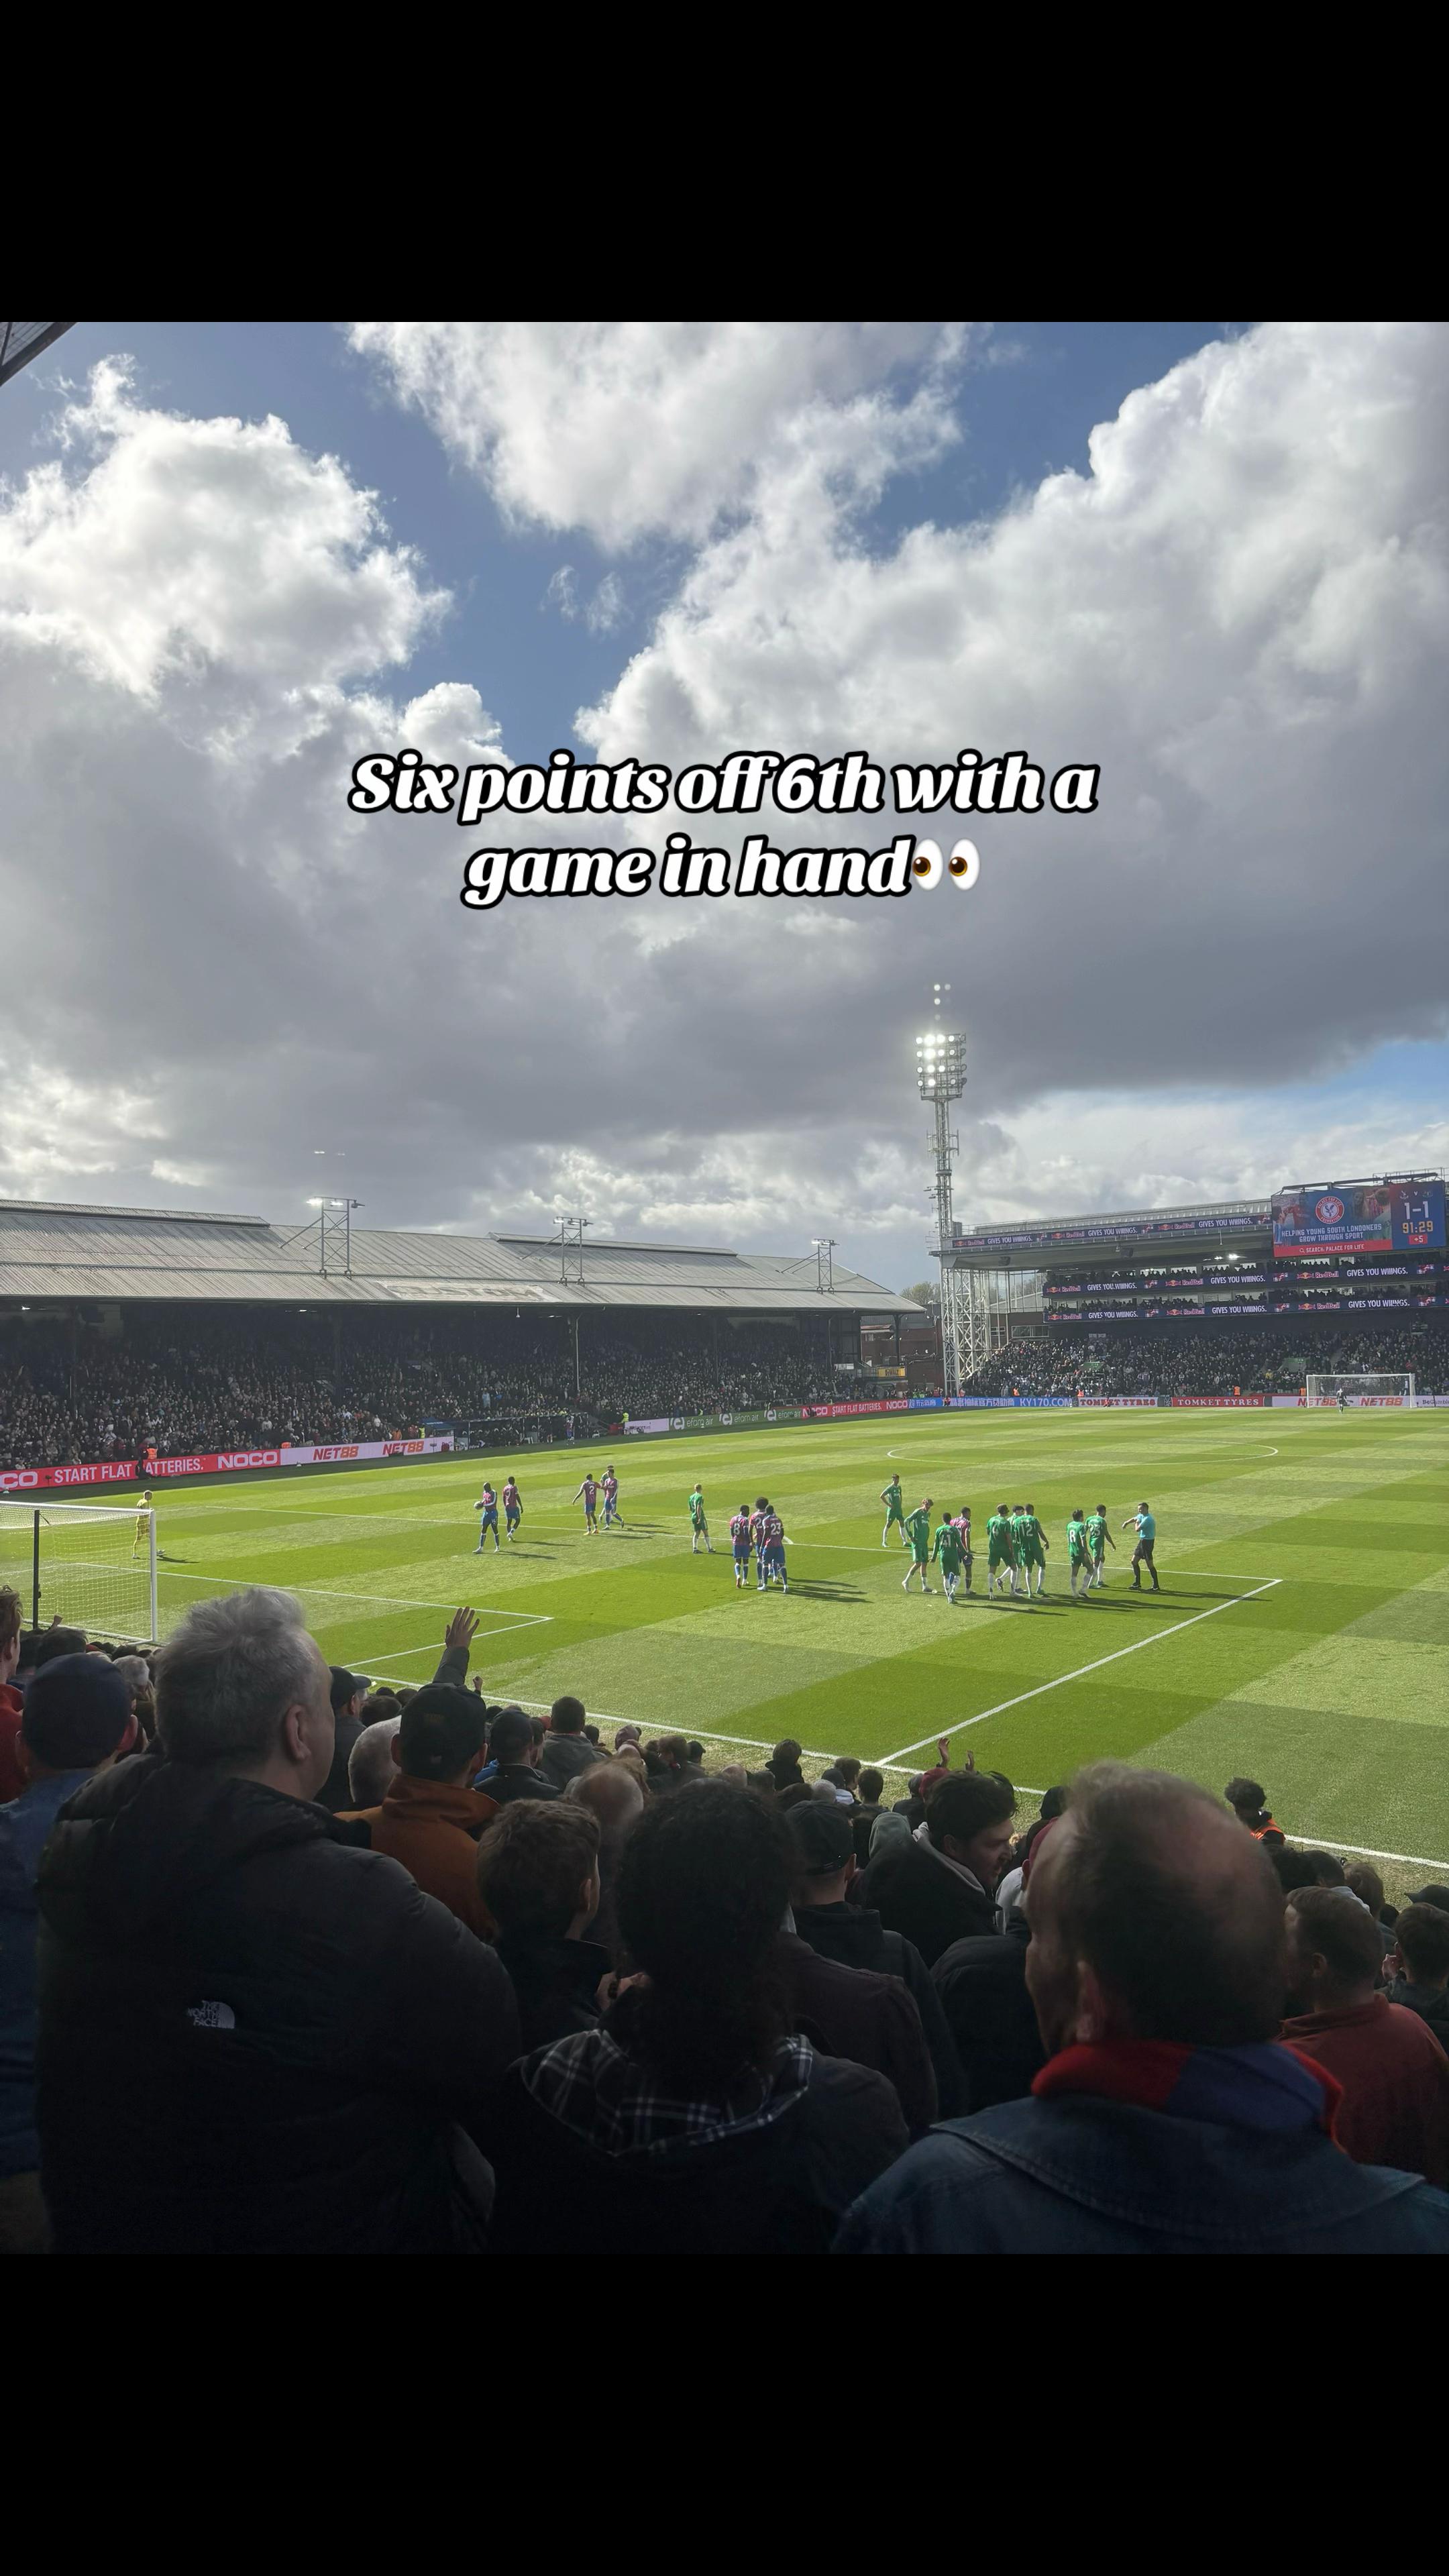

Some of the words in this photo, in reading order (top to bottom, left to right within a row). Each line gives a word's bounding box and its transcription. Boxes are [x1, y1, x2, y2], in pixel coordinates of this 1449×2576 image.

[1404, 1201, 1429, 1220] 1-1
[1198, 1220, 1214, 1228] GIVES
[1216, 1219, 1228, 1227] YOU
[1402, 1221, 1433, 1234] 91:29
[1087, 1229, 1103, 1237] GIVES
[1103, 1228, 1115, 1236] YOU
[1281, 1229, 1305, 1238] HELPING
[1327, 1226, 1346, 1234] SOUTH
[1346, 1224, 1382, 1232] LONDONERS
[987, 1237, 1001, 1245] GIVES
[1318, 1233, 1344, 1241] THROUGH
[1345, 1232, 1364, 1240] SPORT
[1413, 1235, 1424, 1243] +5
[1346, 1269, 1364, 1277] GIVES
[1210, 1277, 1227, 1285] GIVES
[1103, 1283, 1114, 1291] YOU
[1348, 1301, 1366, 1309] GIVES
[1212, 1307, 1228, 1315] GIVES
[886, 1400, 908, 1409] NOCO
[1020, 1397, 1073, 1407] KY170.COM
[1297, 1397, 1338, 1407] NET88
[1360, 1397, 1404, 1407] NET88
[832, 1405, 846, 1415] START
[847, 1405, 858, 1413] FLAT
[859, 1403, 882, 1412] BATTERIES.
[705, 1416, 713, 1426] air
[313, 1445, 359, 1460] NET88
[382, 1441, 425, 1456] NET88
[217, 1451, 278, 1469] NOCO
[54, 1466, 97, 1484] START
[101, 1464, 132, 1479] FLAT
[145, 1458, 203, 1474] ATTERIES.
[589, 1485, 595, 1495] 2
[734, 1523, 741, 1536] 8
[770, 1522, 782, 1536] 23
[1020, 1523, 1034, 1537] 12
[202, 2000, 220, 2011] THE
[187, 2008, 221, 2020] NORTH
[193, 2017, 217, 2027] FACE
